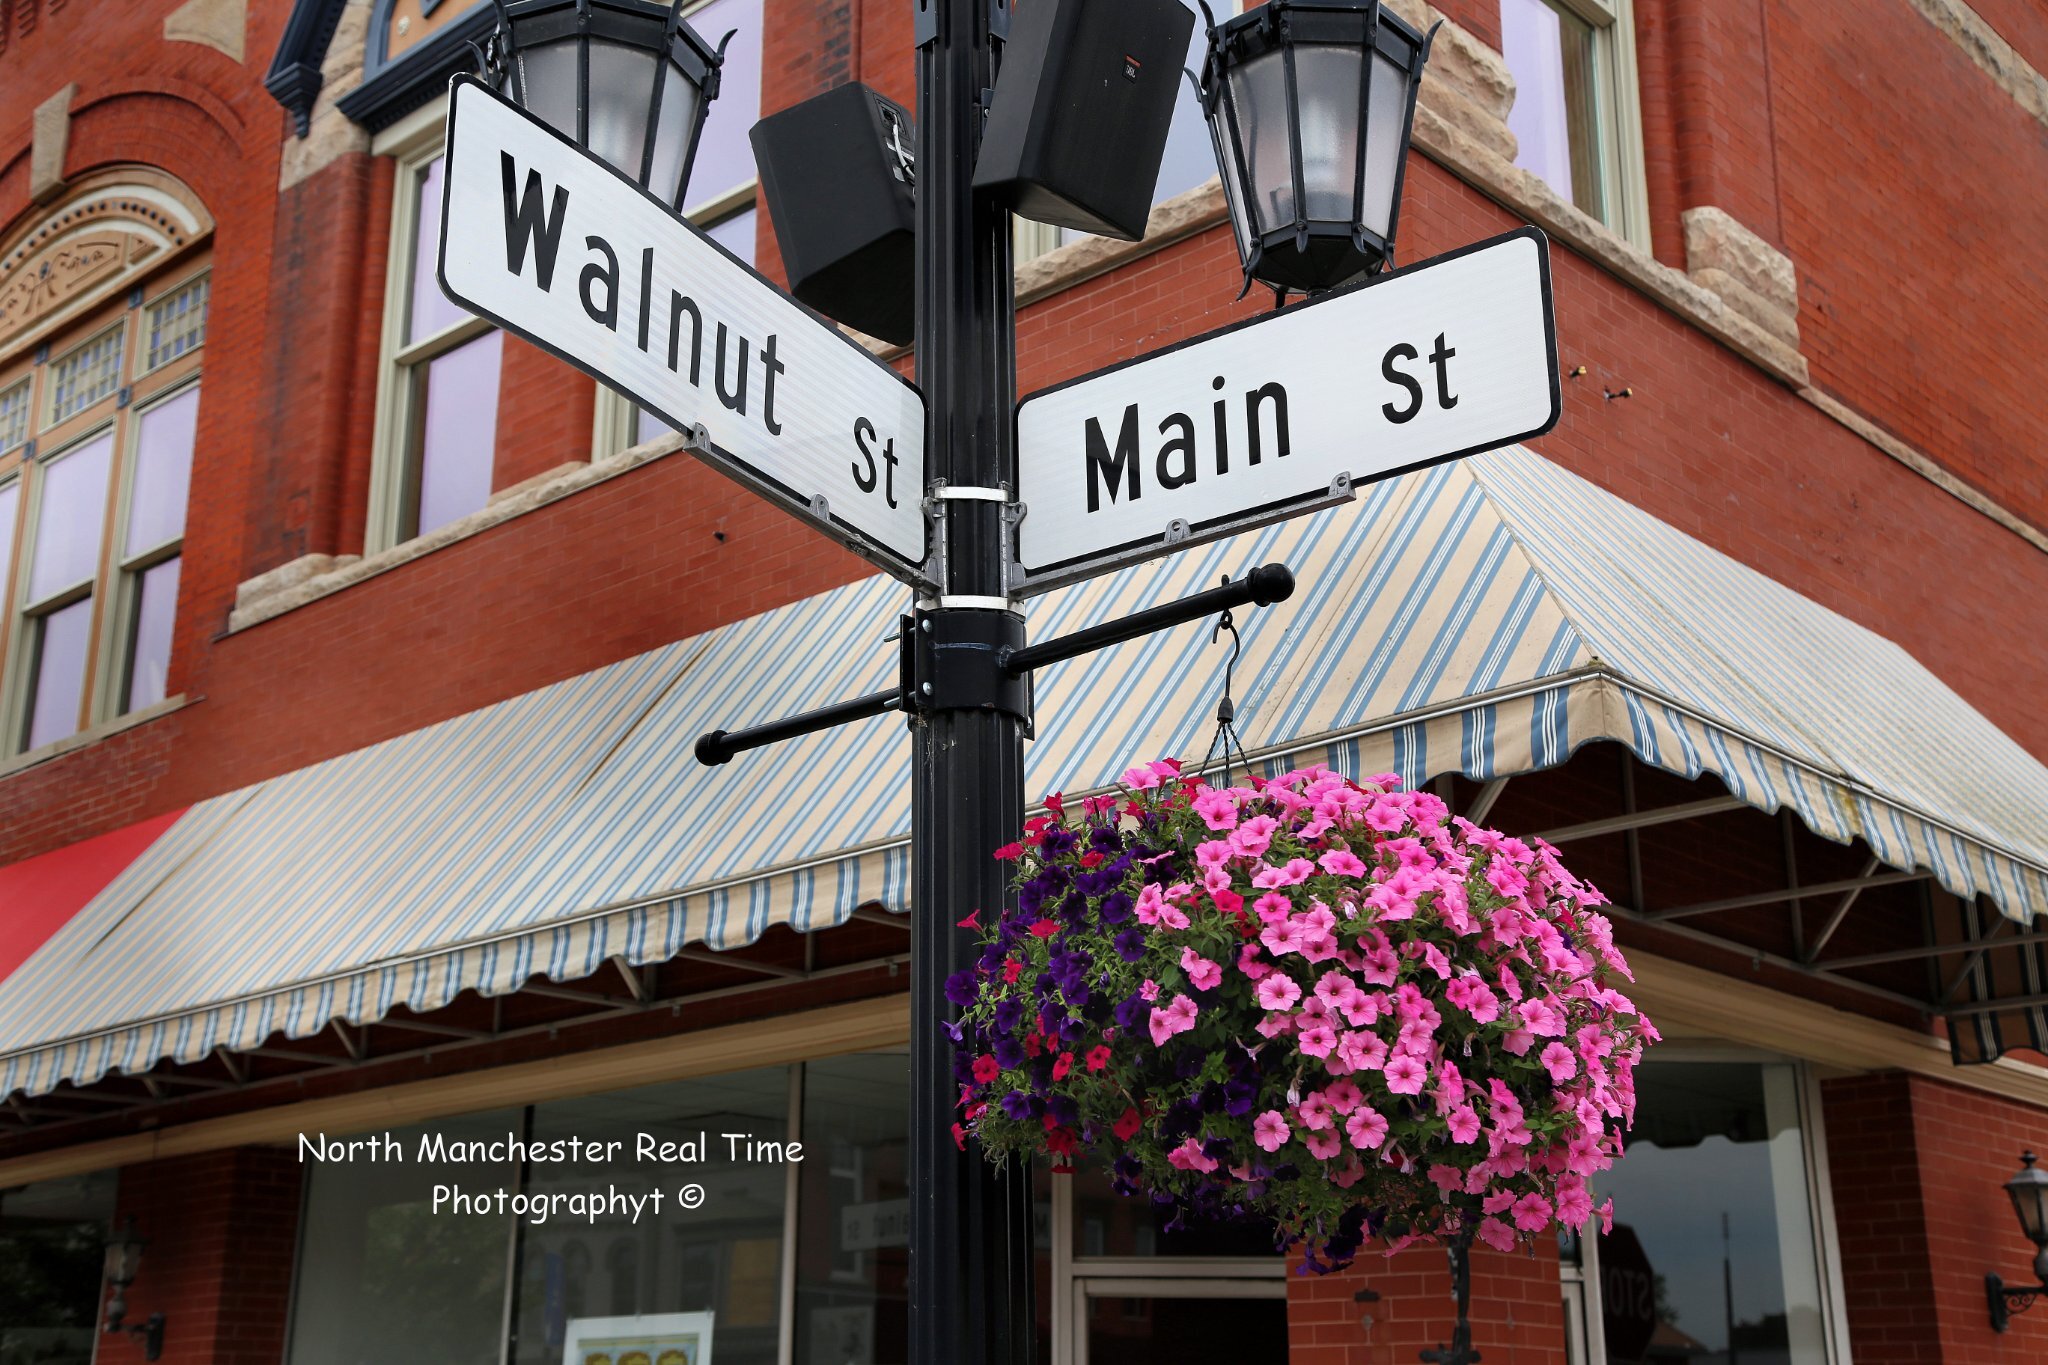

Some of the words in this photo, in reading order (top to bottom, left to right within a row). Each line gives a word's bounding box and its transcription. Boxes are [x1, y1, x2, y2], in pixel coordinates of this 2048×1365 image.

[500, 149, 785, 436] Walnut
[852, 416, 898, 510] St
[1084, 375, 1291, 514] Main
[1381, 332, 1459, 425] St
